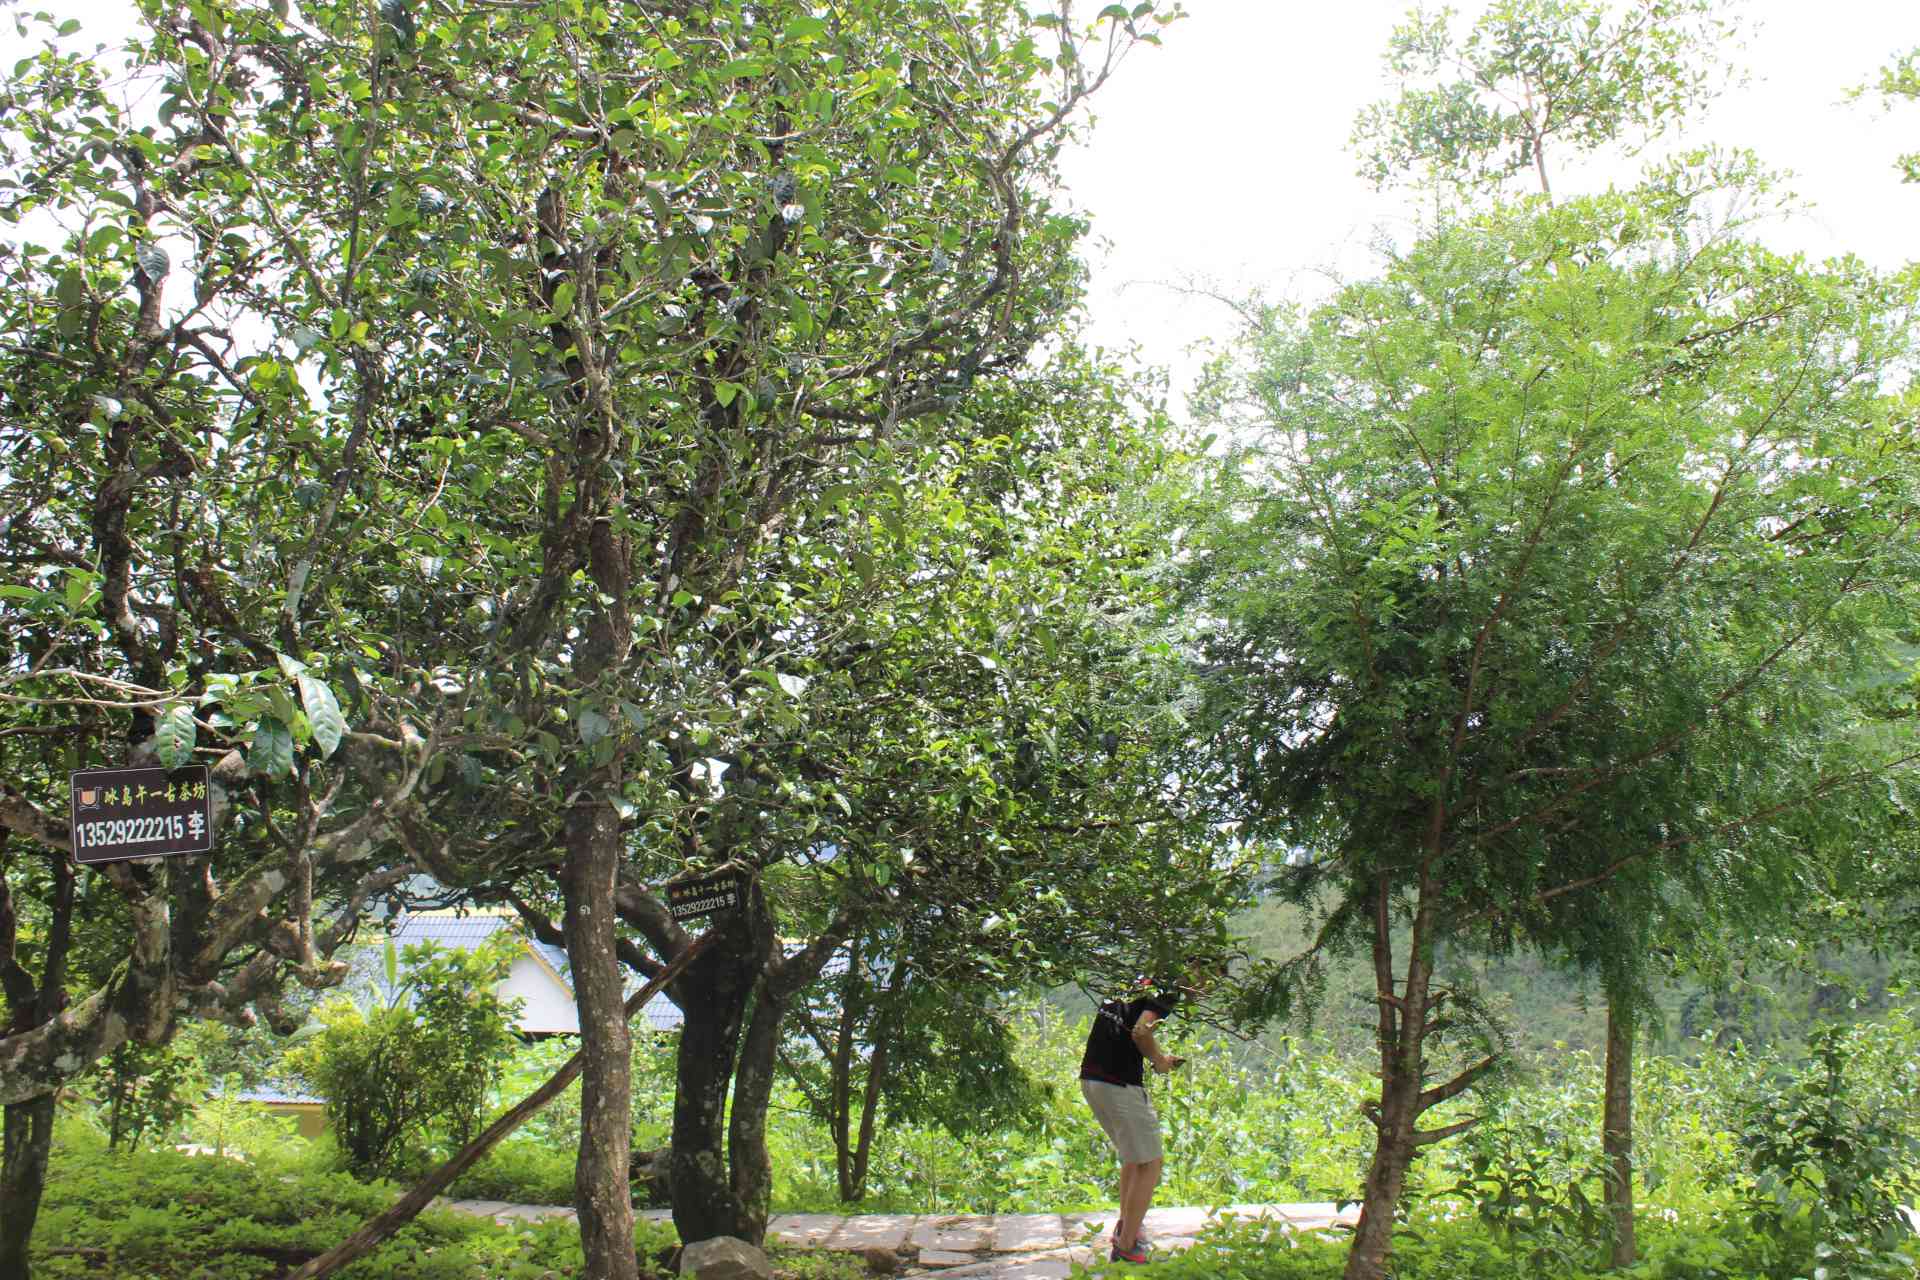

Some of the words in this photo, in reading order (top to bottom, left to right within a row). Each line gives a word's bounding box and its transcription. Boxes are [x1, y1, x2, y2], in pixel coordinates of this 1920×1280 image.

[77, 815, 183, 848] 13529222215
[188, 810, 205, 841] 李
[672, 896, 725, 917] 13529222215
